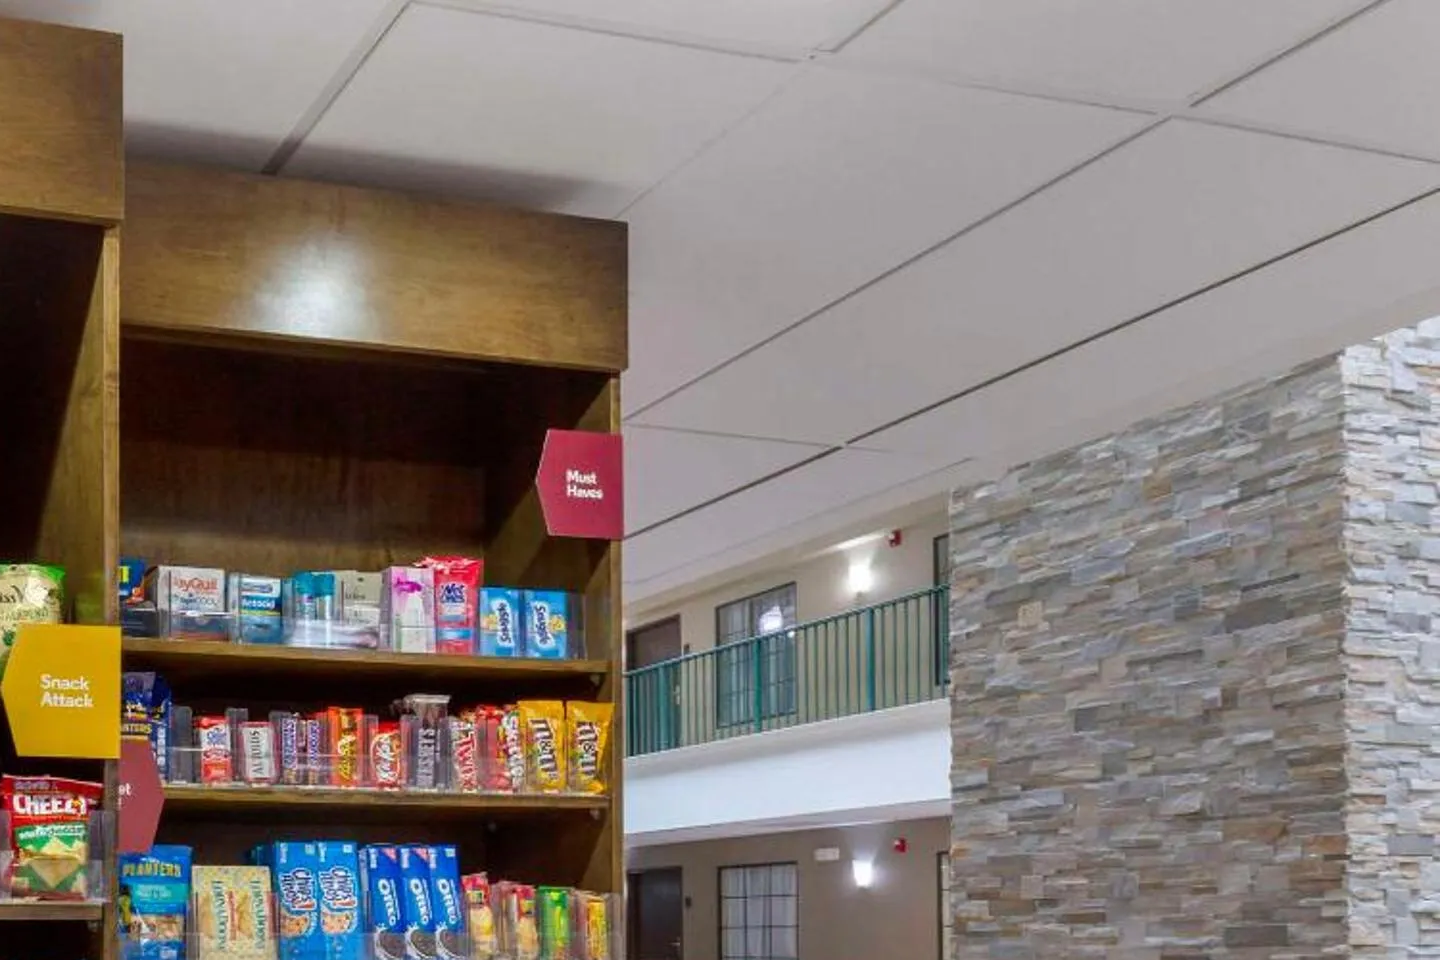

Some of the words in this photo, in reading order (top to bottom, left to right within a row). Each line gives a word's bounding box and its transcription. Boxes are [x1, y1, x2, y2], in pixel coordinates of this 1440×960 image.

[565, 468, 597, 485] Must
[566, 484, 604, 499] Haves
[39, 673, 90, 691] Snack
[40, 691, 94, 709] Attack
[122, 863, 182, 878] PLANTERS
[378, 878, 396, 926] OREO
[410, 878, 429, 925] OREO
[437, 878, 456, 925] OREO
